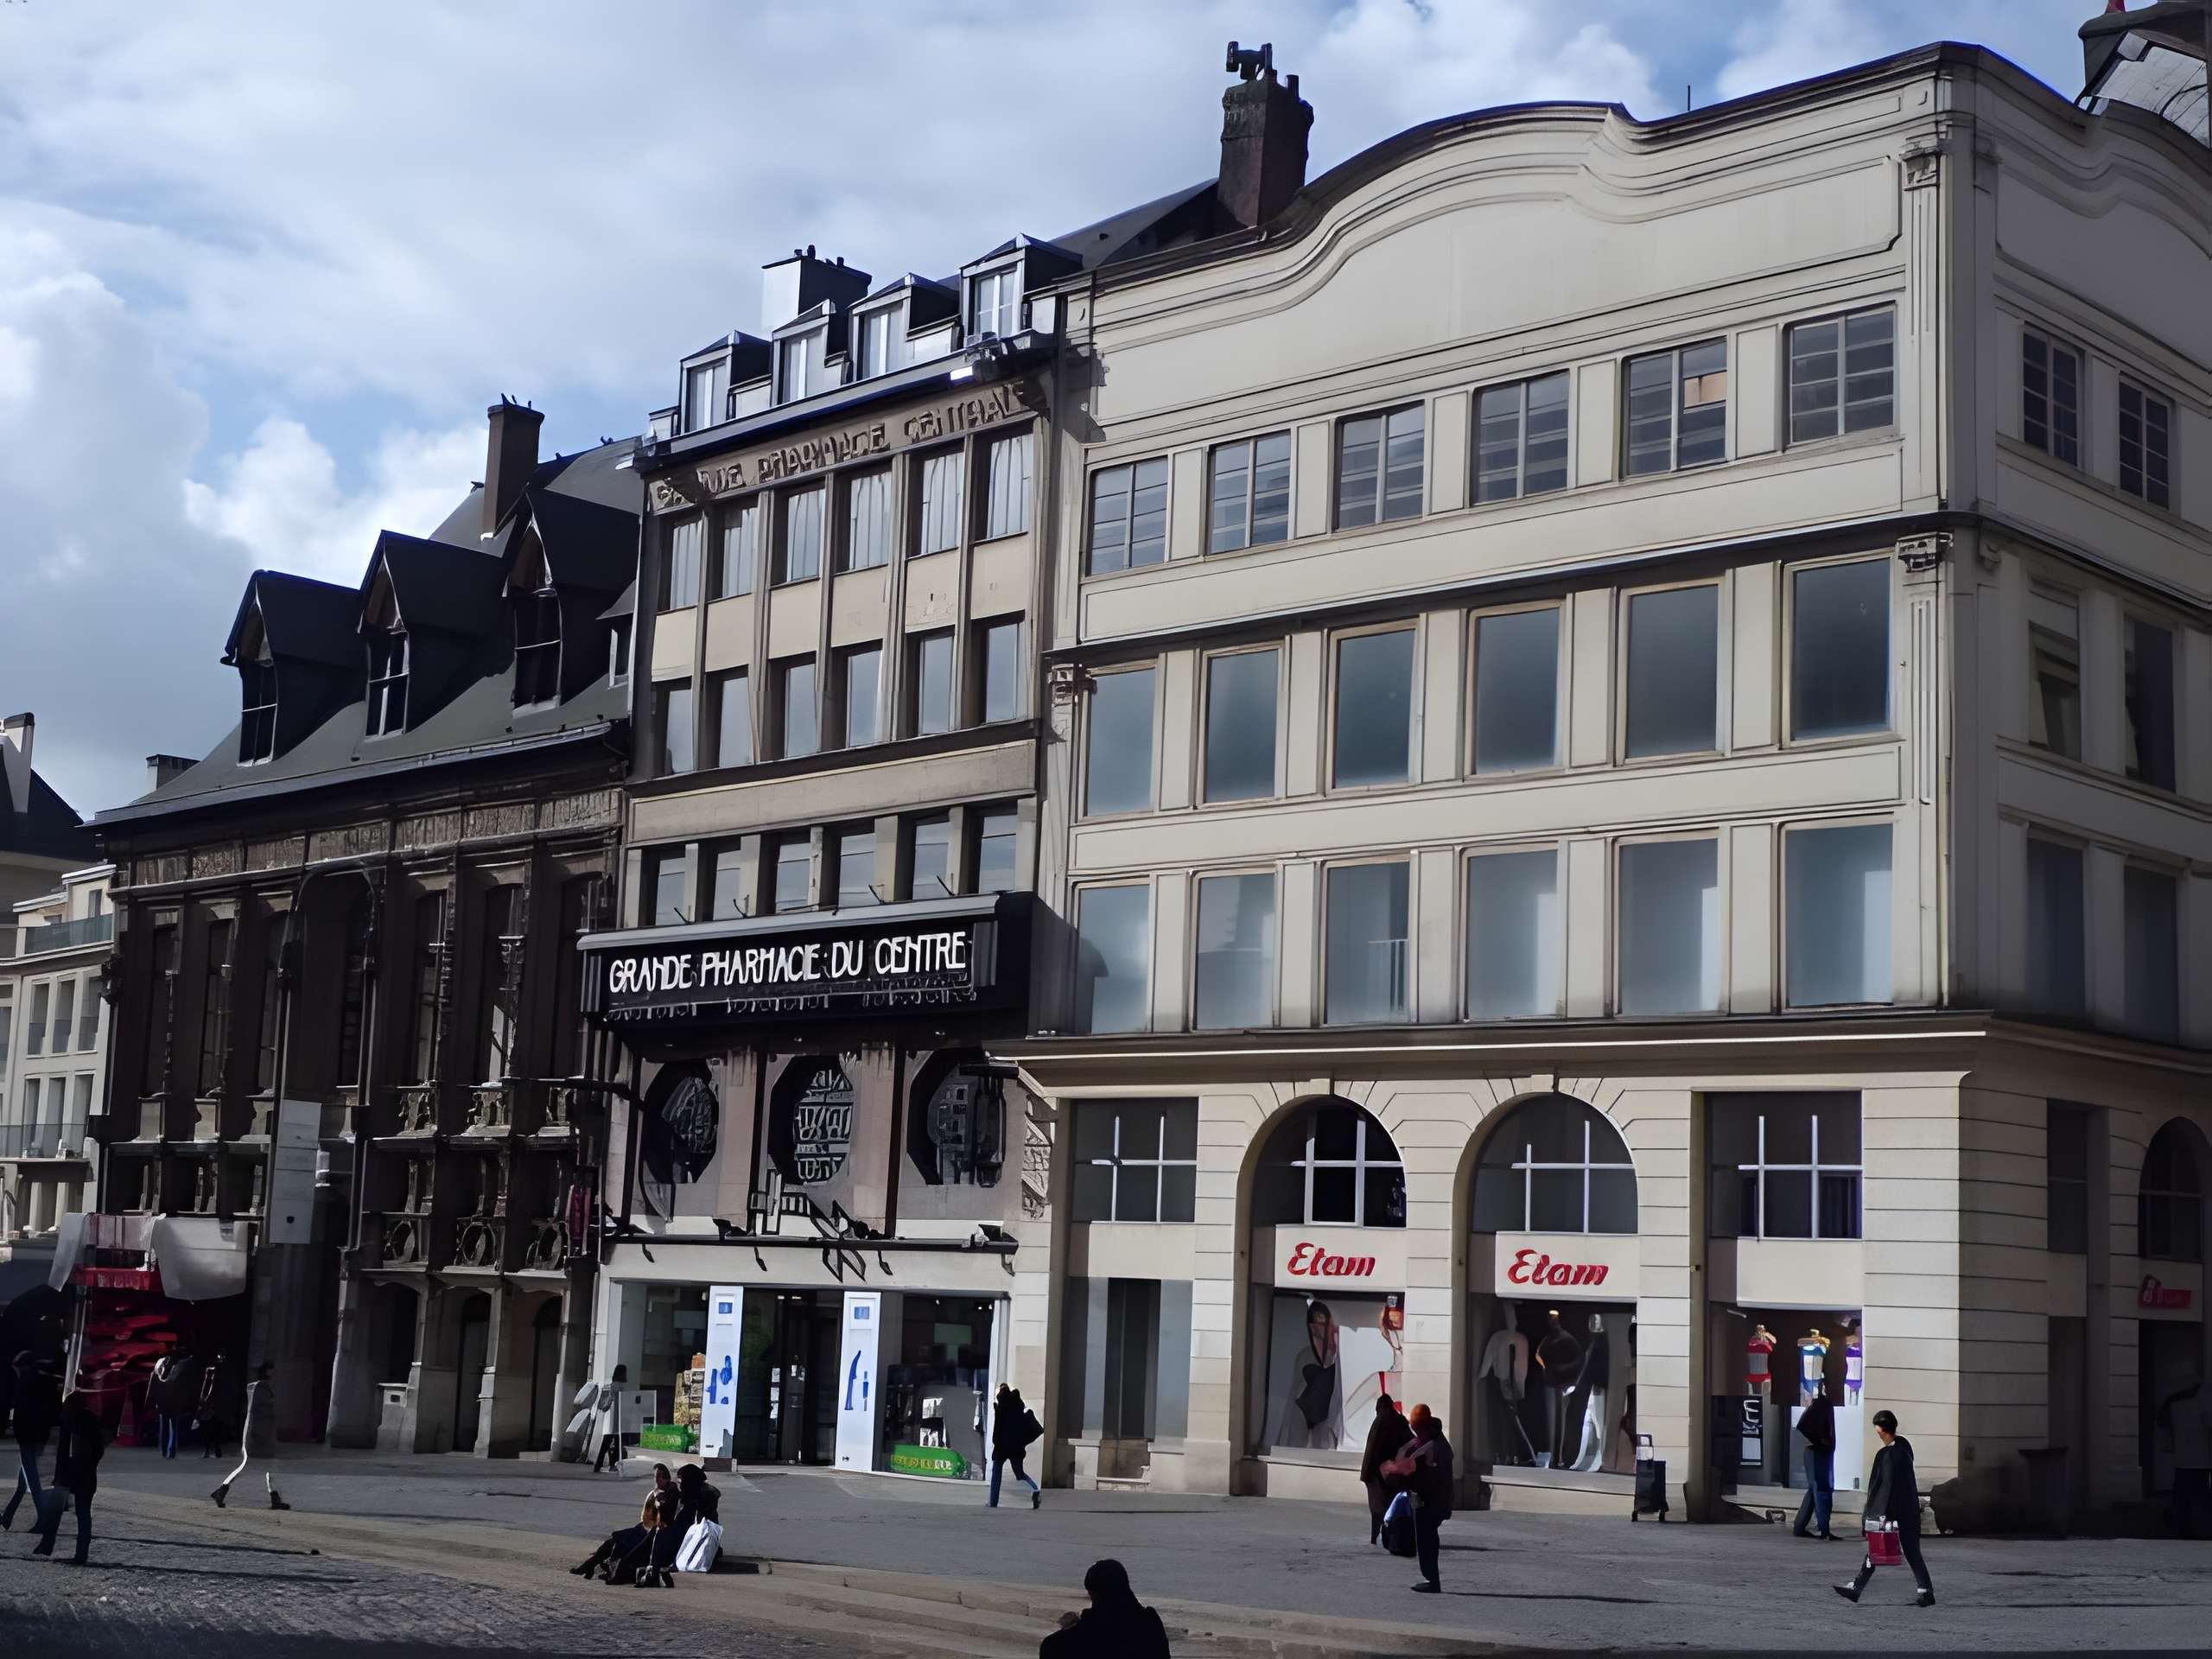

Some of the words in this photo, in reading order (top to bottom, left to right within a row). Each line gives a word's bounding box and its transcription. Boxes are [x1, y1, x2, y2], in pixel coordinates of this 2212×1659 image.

[609, 954, 693, 994] GRANDE
[699, 943, 822, 988] PHARMACIE
[831, 939, 864, 979] DU
[874, 931, 966, 975] CENTRE
[1287, 1242, 1376, 1277] Etam
[1507, 1248, 1610, 1286] Etam
